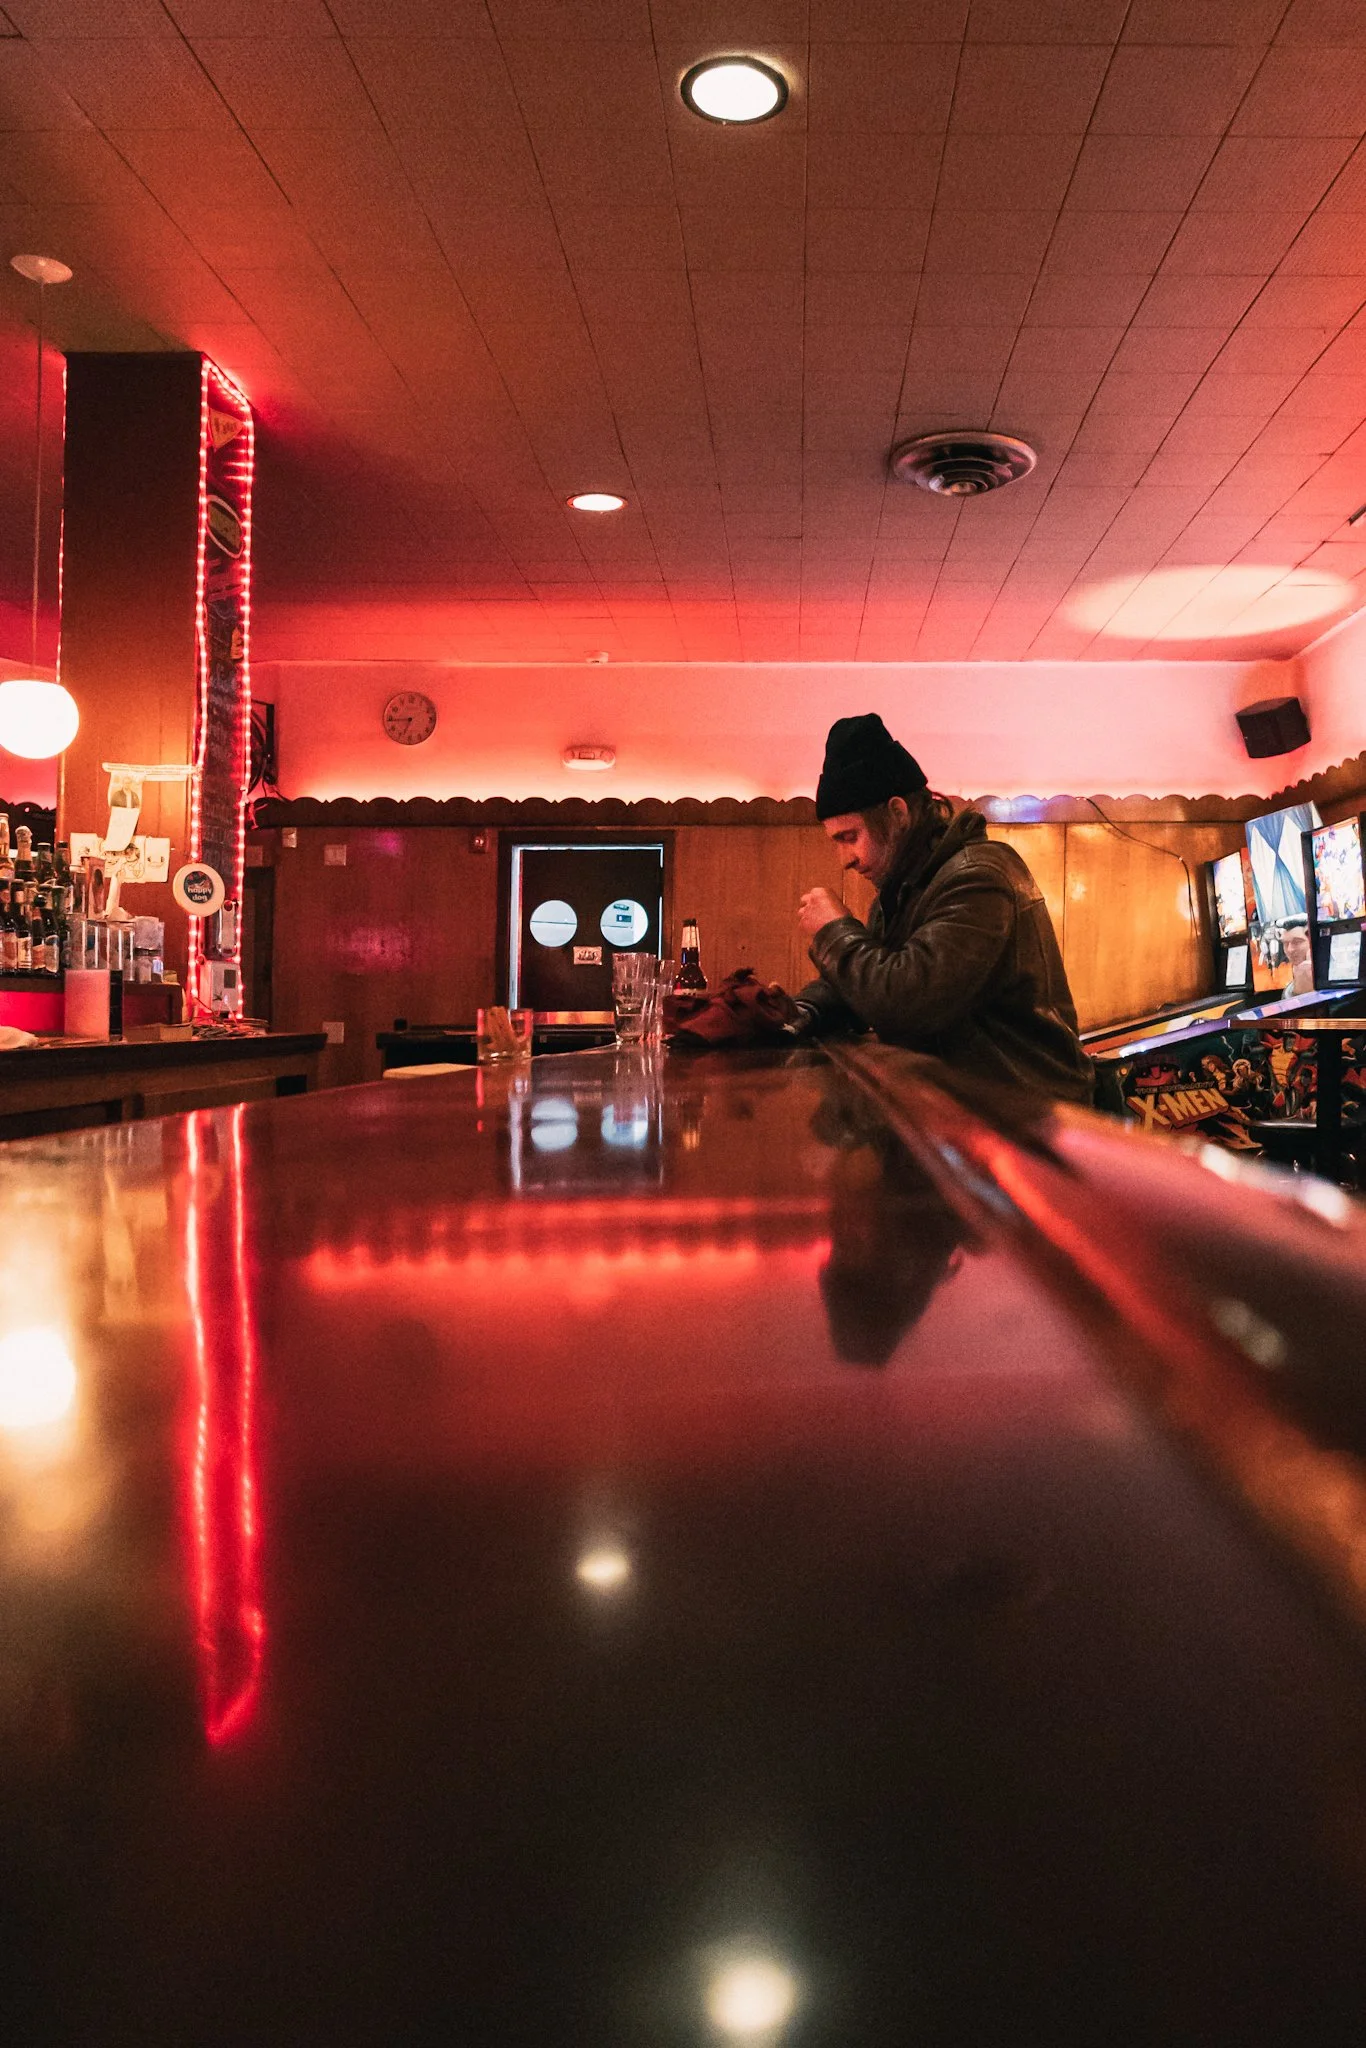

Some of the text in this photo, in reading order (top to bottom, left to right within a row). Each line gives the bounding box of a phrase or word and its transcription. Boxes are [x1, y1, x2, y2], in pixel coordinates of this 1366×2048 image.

[187, 886, 212, 895] happy
[192, 894, 208, 902] dog
[1127, 1088, 1229, 1131] X-MEN
